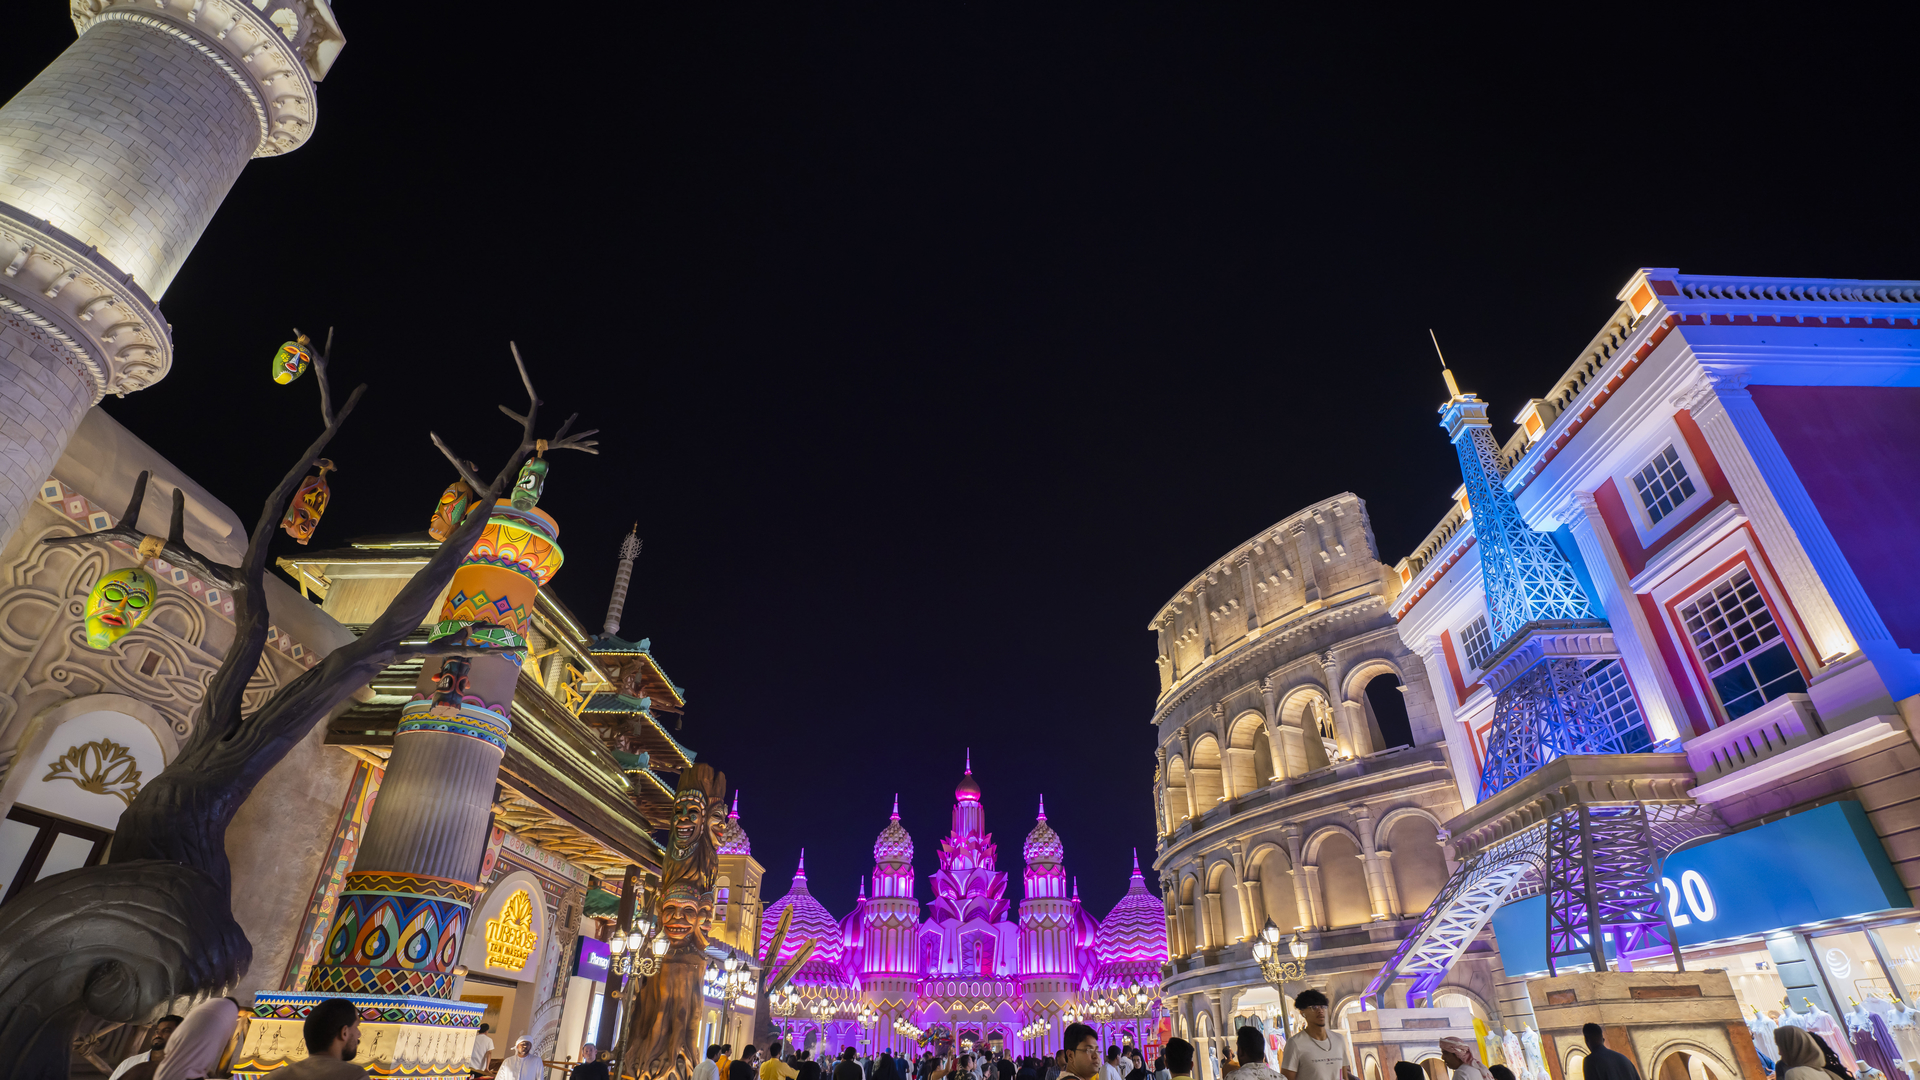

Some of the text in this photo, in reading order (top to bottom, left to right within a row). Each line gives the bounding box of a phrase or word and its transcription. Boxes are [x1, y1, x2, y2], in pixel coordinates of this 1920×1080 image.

[489, 921, 539, 951] TUBEROSE
[490, 942, 529, 961] THAI MASSAGE
